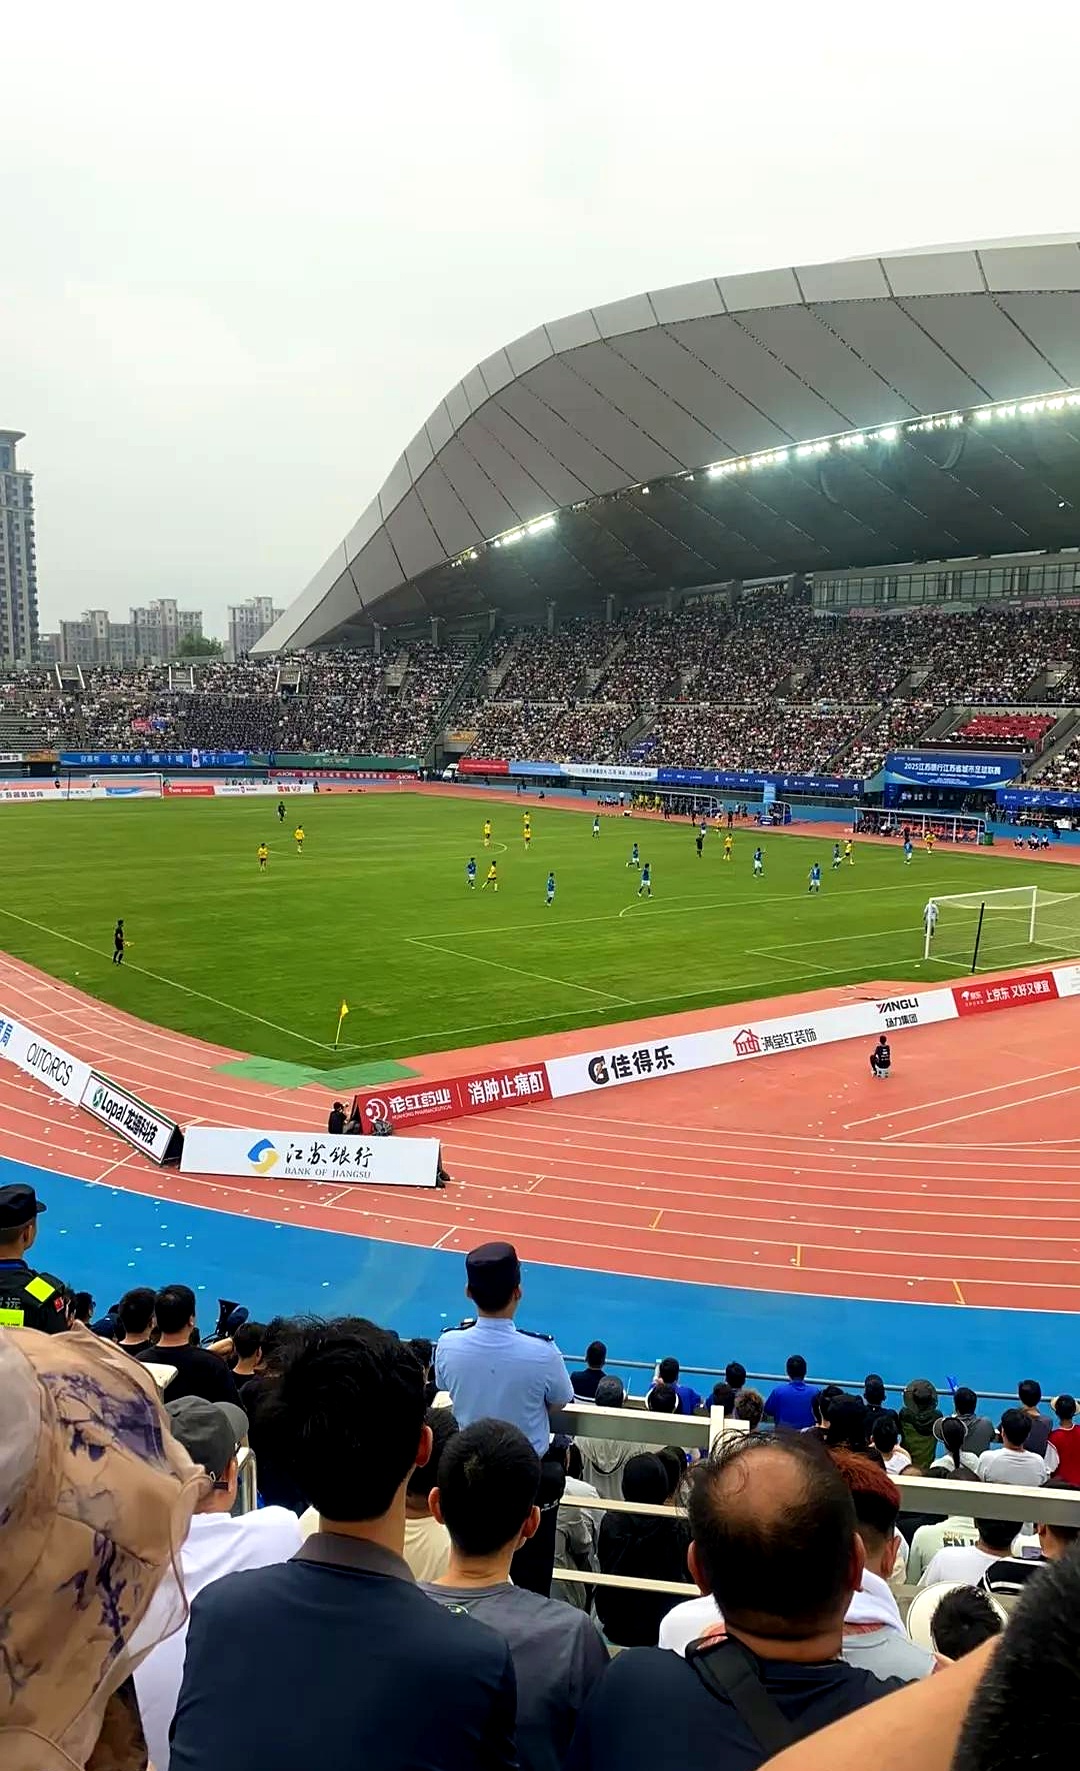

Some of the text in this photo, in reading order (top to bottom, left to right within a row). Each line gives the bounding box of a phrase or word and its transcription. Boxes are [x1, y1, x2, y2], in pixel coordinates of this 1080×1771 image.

[876, 998, 919, 1014] YANGLI
[986, 987, 1011, 1003] 上京东
[760, 1028, 817, 1051] 满堂红装饰
[610, 1045, 676, 1079] 佳得乐
[467, 1070, 544, 1105] 消肿止痛酊
[100, 1091, 129, 1122] Lopal
[285, 1167, 372, 1179] BANK OF JIANGSU
